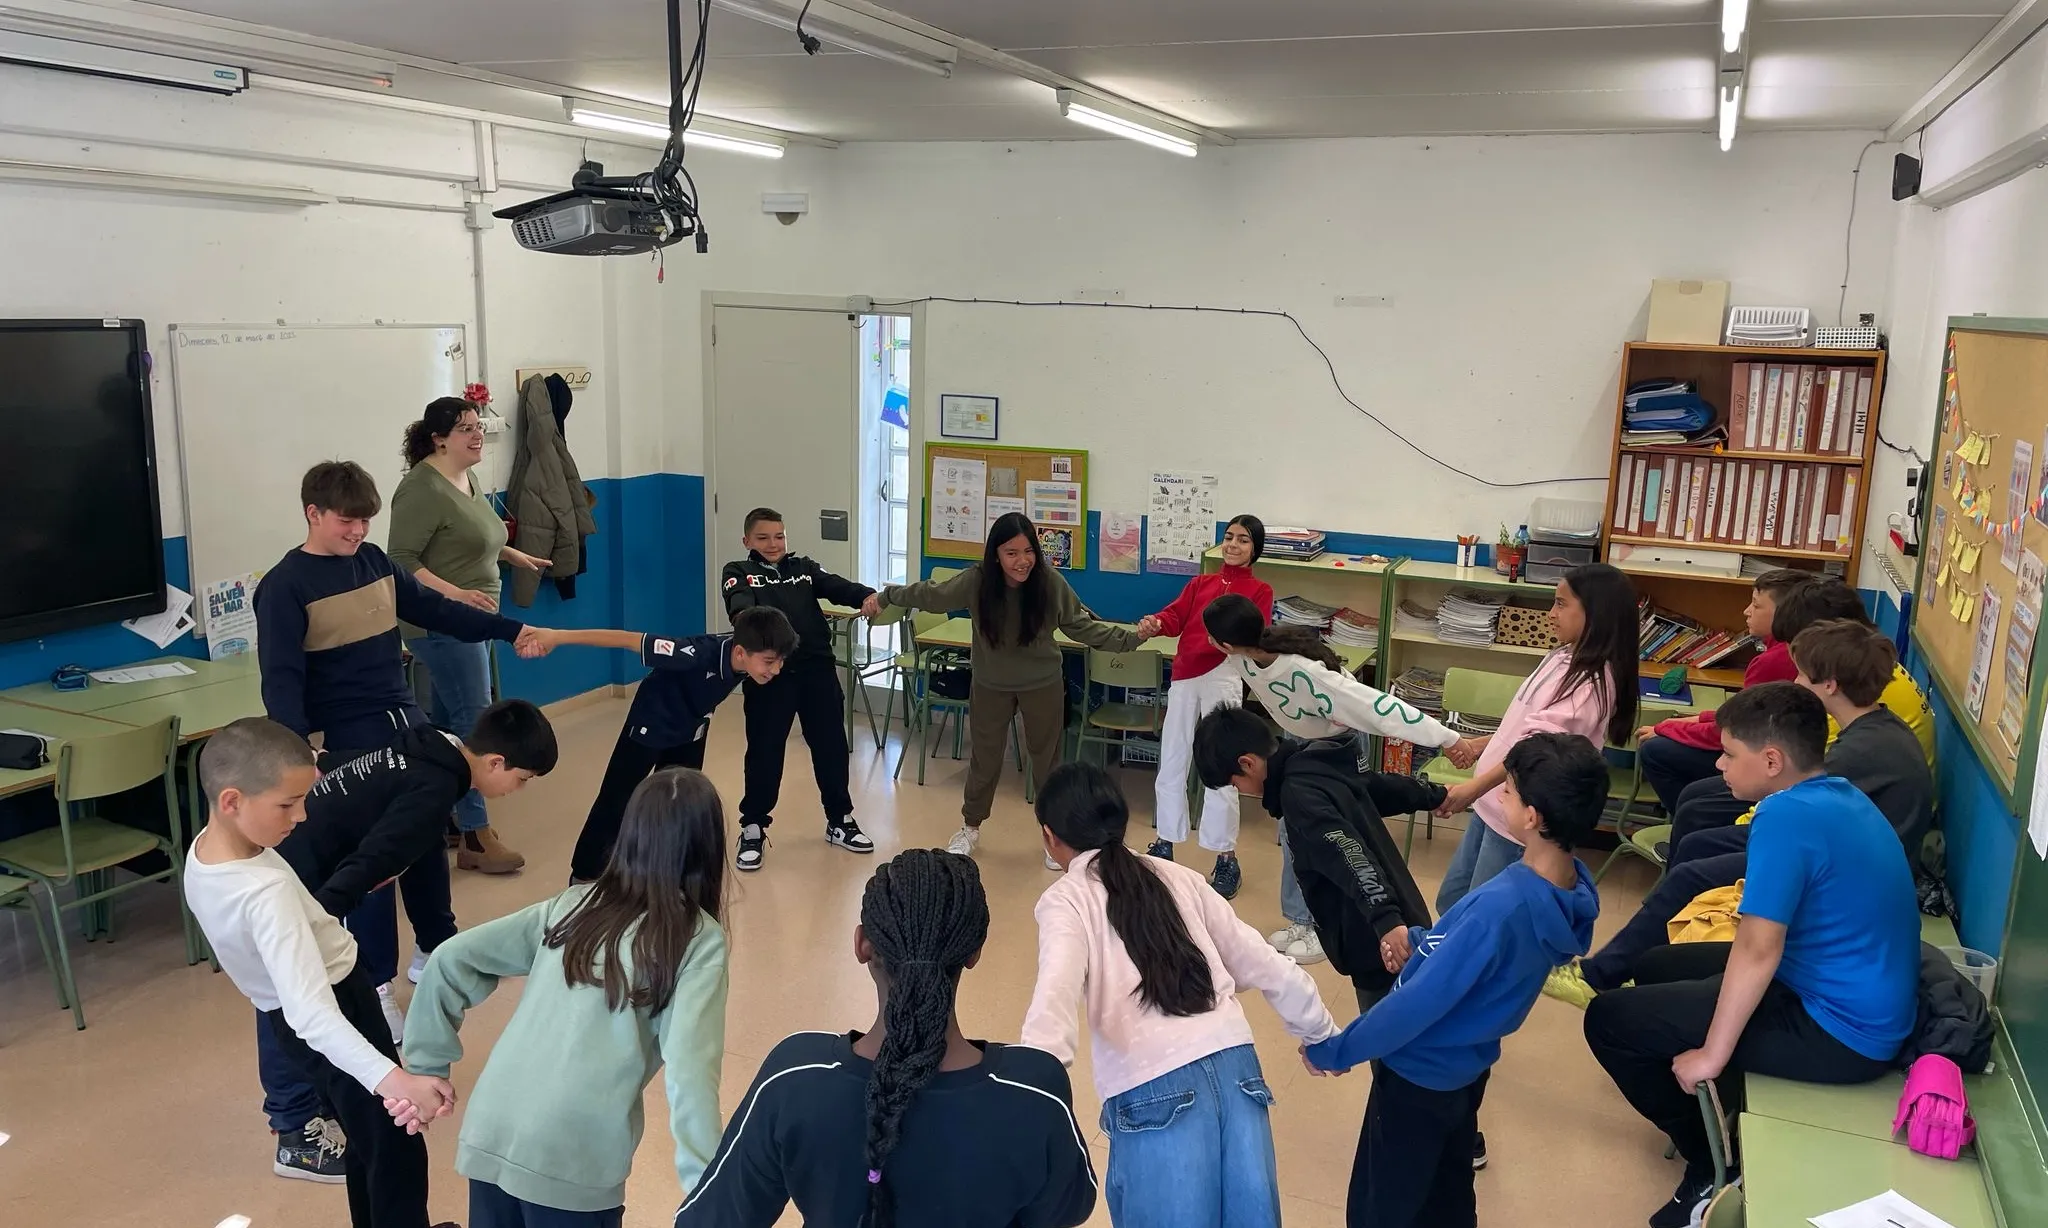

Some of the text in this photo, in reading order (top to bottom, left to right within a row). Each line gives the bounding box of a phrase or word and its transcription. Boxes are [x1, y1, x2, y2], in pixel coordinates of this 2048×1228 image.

[1153, 476, 1184, 485] CALENDARI
[209, 586, 245, 607] SALVEM
[210, 599, 243, 618] EL MAR
